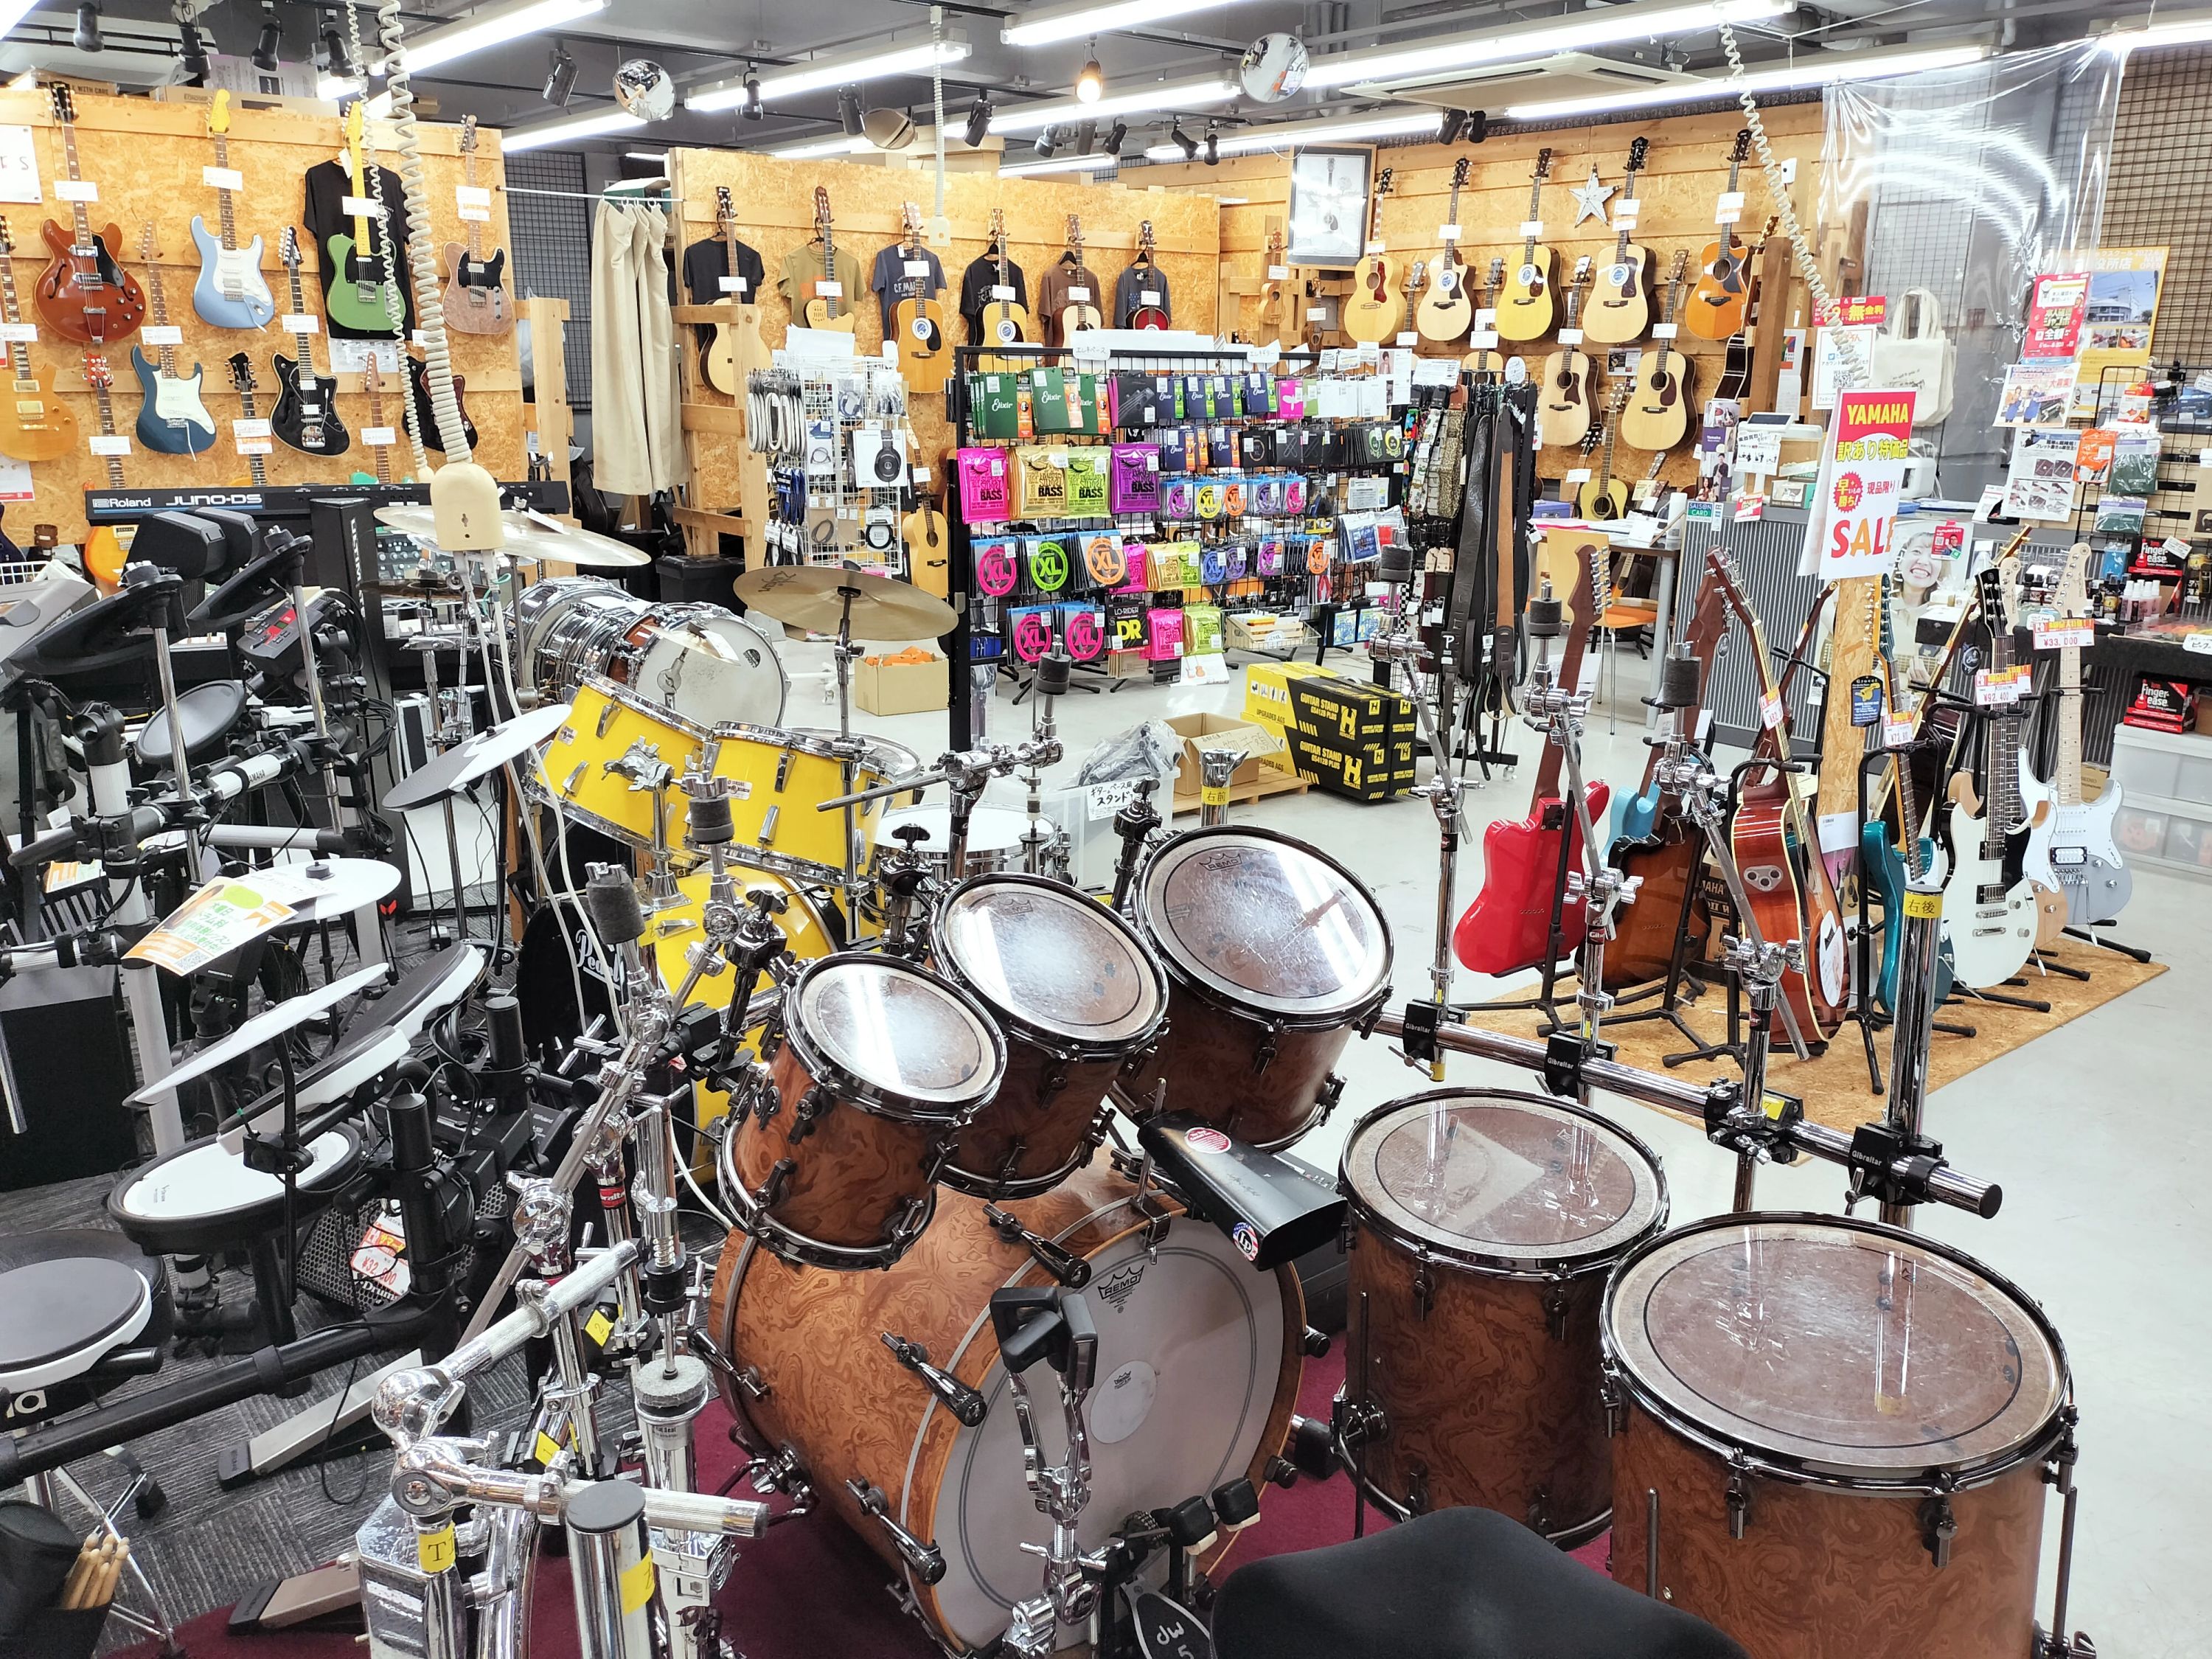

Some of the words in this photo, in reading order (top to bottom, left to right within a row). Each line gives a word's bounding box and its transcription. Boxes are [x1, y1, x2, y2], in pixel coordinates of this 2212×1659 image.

[1042, 391, 1062, 403] Elixir
[992, 398, 1012, 411] Elixir
[1847, 403, 1908, 425] YAMAHA
[1836, 439, 1908, 462] 訳あり特価品
[1038, 487, 1062, 496] BASS
[1079, 489, 1103, 498] BASS
[1132, 481, 1154, 493] BASS
[110, 497, 152, 507] Roland
[166, 494, 262, 506] JUNO-DS
[981, 490, 1002, 501] BASS
[1038, 557, 1062, 577] XL
[1094, 552, 1119, 571] XL
[1208, 563, 1221, 574] XL
[987, 561, 1009, 582] XL
[1114, 607, 1139, 615] LO-RIDER
[1116, 619, 1142, 640] DR
[1023, 630, 1046, 648] XL
[1074, 628, 1099, 647] XL
[1300, 692, 1320, 707] GUITAR
[1321, 699, 1339, 713] STAND
[1256, 709, 1277, 721] UPGRADED
[1277, 715, 1285, 723] AGS
[1300, 740, 1321, 757] GUITAR
[1322, 747, 1342, 762] STAND
[1276, 762, 1284, 772] AGS
[1328, 760, 1340, 770] PLUS
[249, 769, 265, 782] AMAHA
[1206, 790, 1225, 802] 右前
[1908, 899, 1935, 914] 右後
[1405, 1023, 1431, 1033] Gibraltar
[1547, 1057, 1574, 1070] Gibraltar
[1851, 1150, 1882, 1166] Gibraltar
[1240, 1231, 1252, 1253] LP
[1105, 1274, 1141, 1296] REMO
[1156, 1621, 1185, 1645] dw
